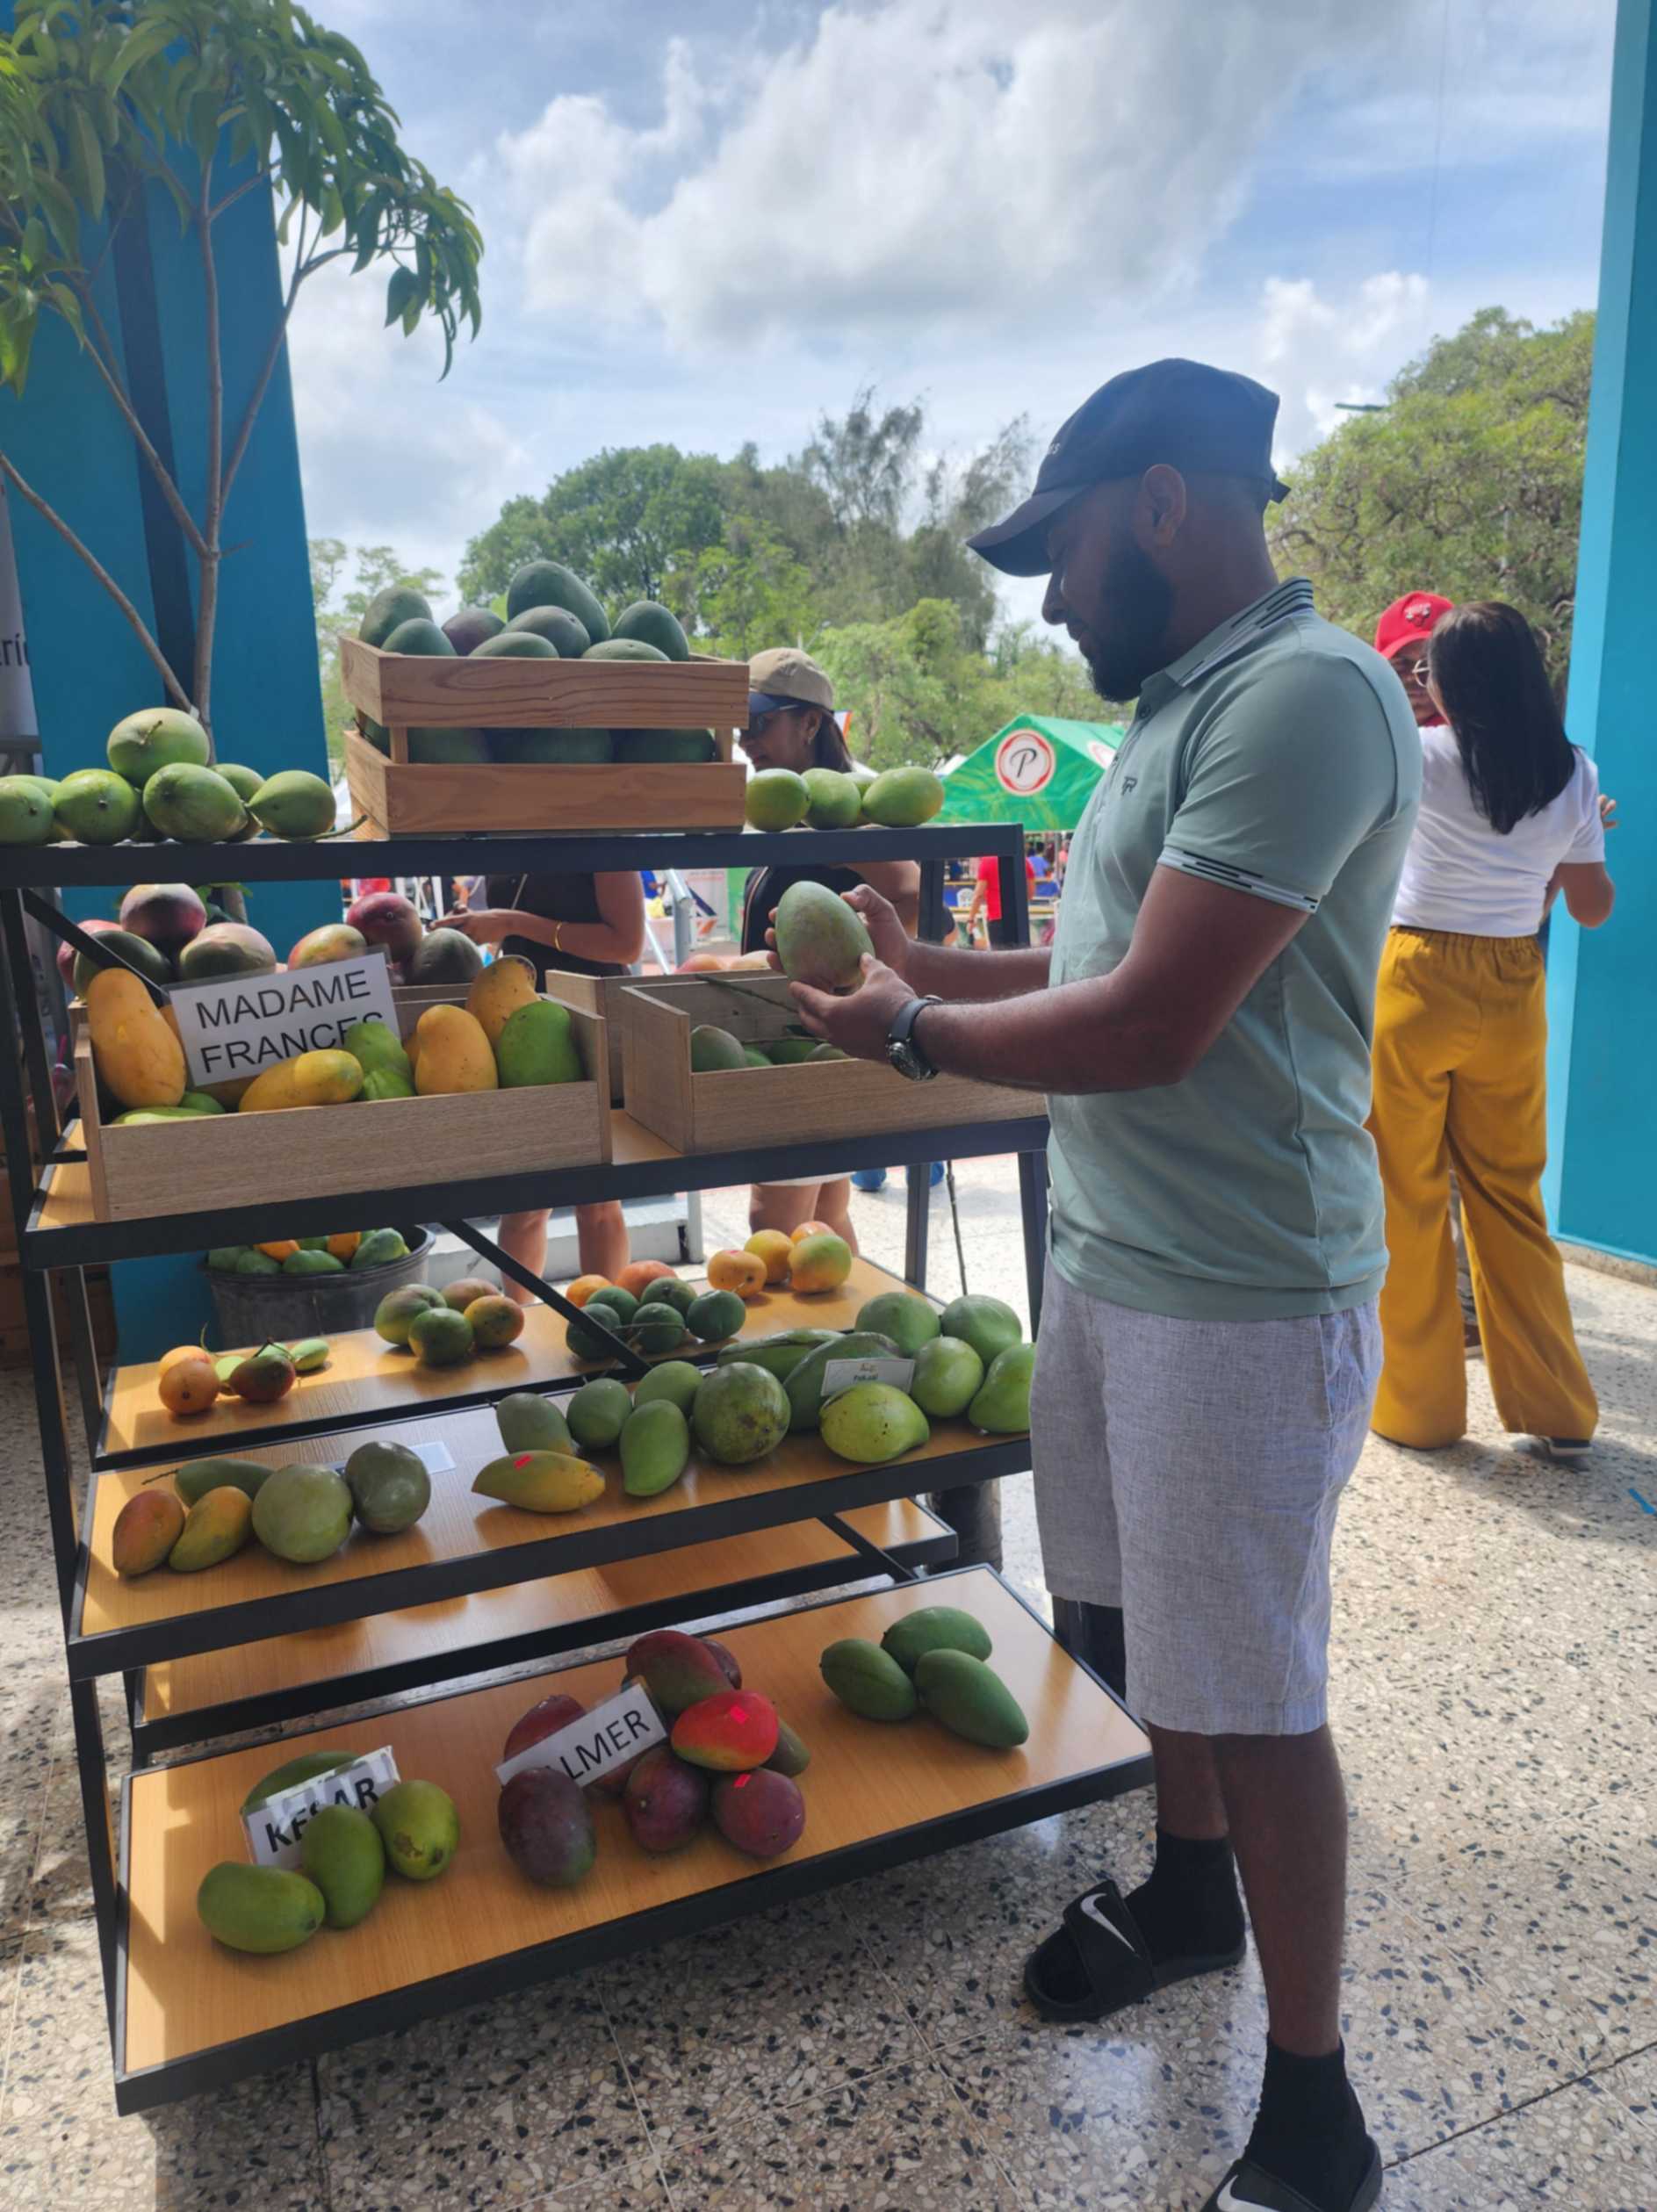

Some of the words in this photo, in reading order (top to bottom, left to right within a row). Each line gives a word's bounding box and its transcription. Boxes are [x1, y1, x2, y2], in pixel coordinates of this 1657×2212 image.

[1009, 747, 1038, 779] P
[196, 969, 371, 1029] MADAME
[199, 1011, 384, 1073] FRANC
[545, 1709, 652, 1780] LMER
